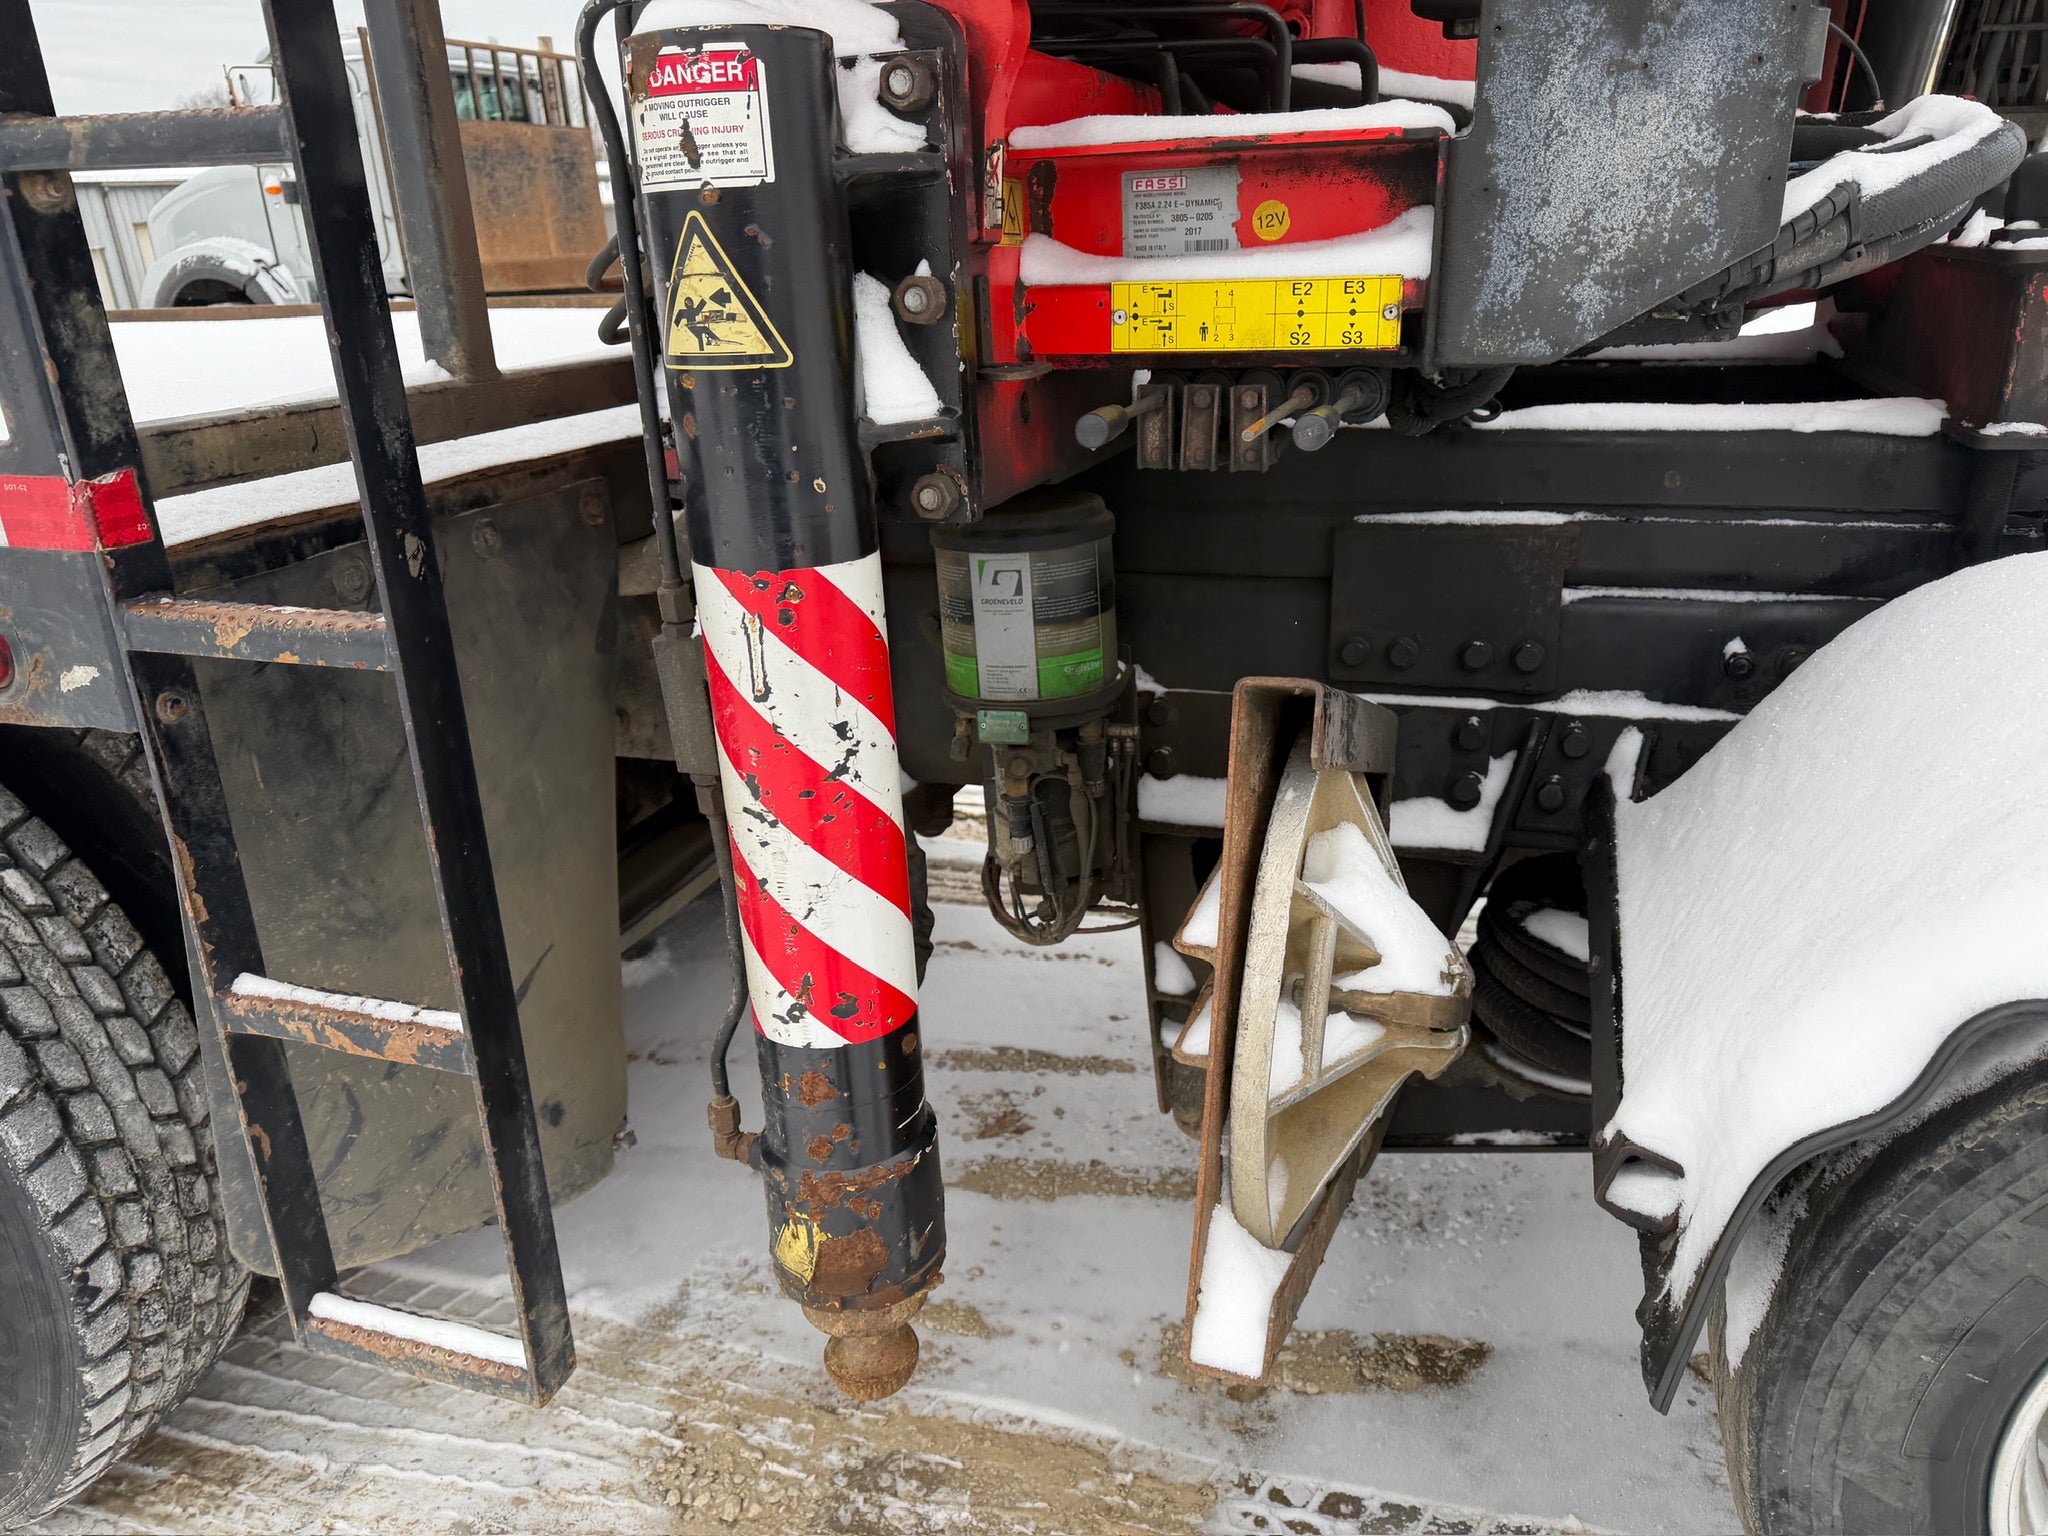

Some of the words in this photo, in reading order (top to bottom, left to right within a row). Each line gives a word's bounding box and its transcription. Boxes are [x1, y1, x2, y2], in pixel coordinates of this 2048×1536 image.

[649, 61, 744, 87] DANGER
[649, 100, 675, 111] MOVING
[678, 98, 730, 108] OUTRIGGER
[659, 112, 677, 122] WILL
[679, 110, 708, 120] CAUSE
[642, 130, 666, 141] SERIOUS
[712, 125, 744, 134] INJURY
[1136, 178, 1183, 189] FASSI
[1257, 211, 1285, 229] 12V
[1185, 227, 1201, 236] 2017
[1292, 283, 1313, 296] E2
[1344, 281, 1365, 294] E3
[1168, 302, 1174, 311] S
[1168, 336, 1174, 344] S
[1290, 332, 1310, 345] S2
[1341, 331, 1363, 344] S3
[4, 483, 28, 492] DOT-C2
